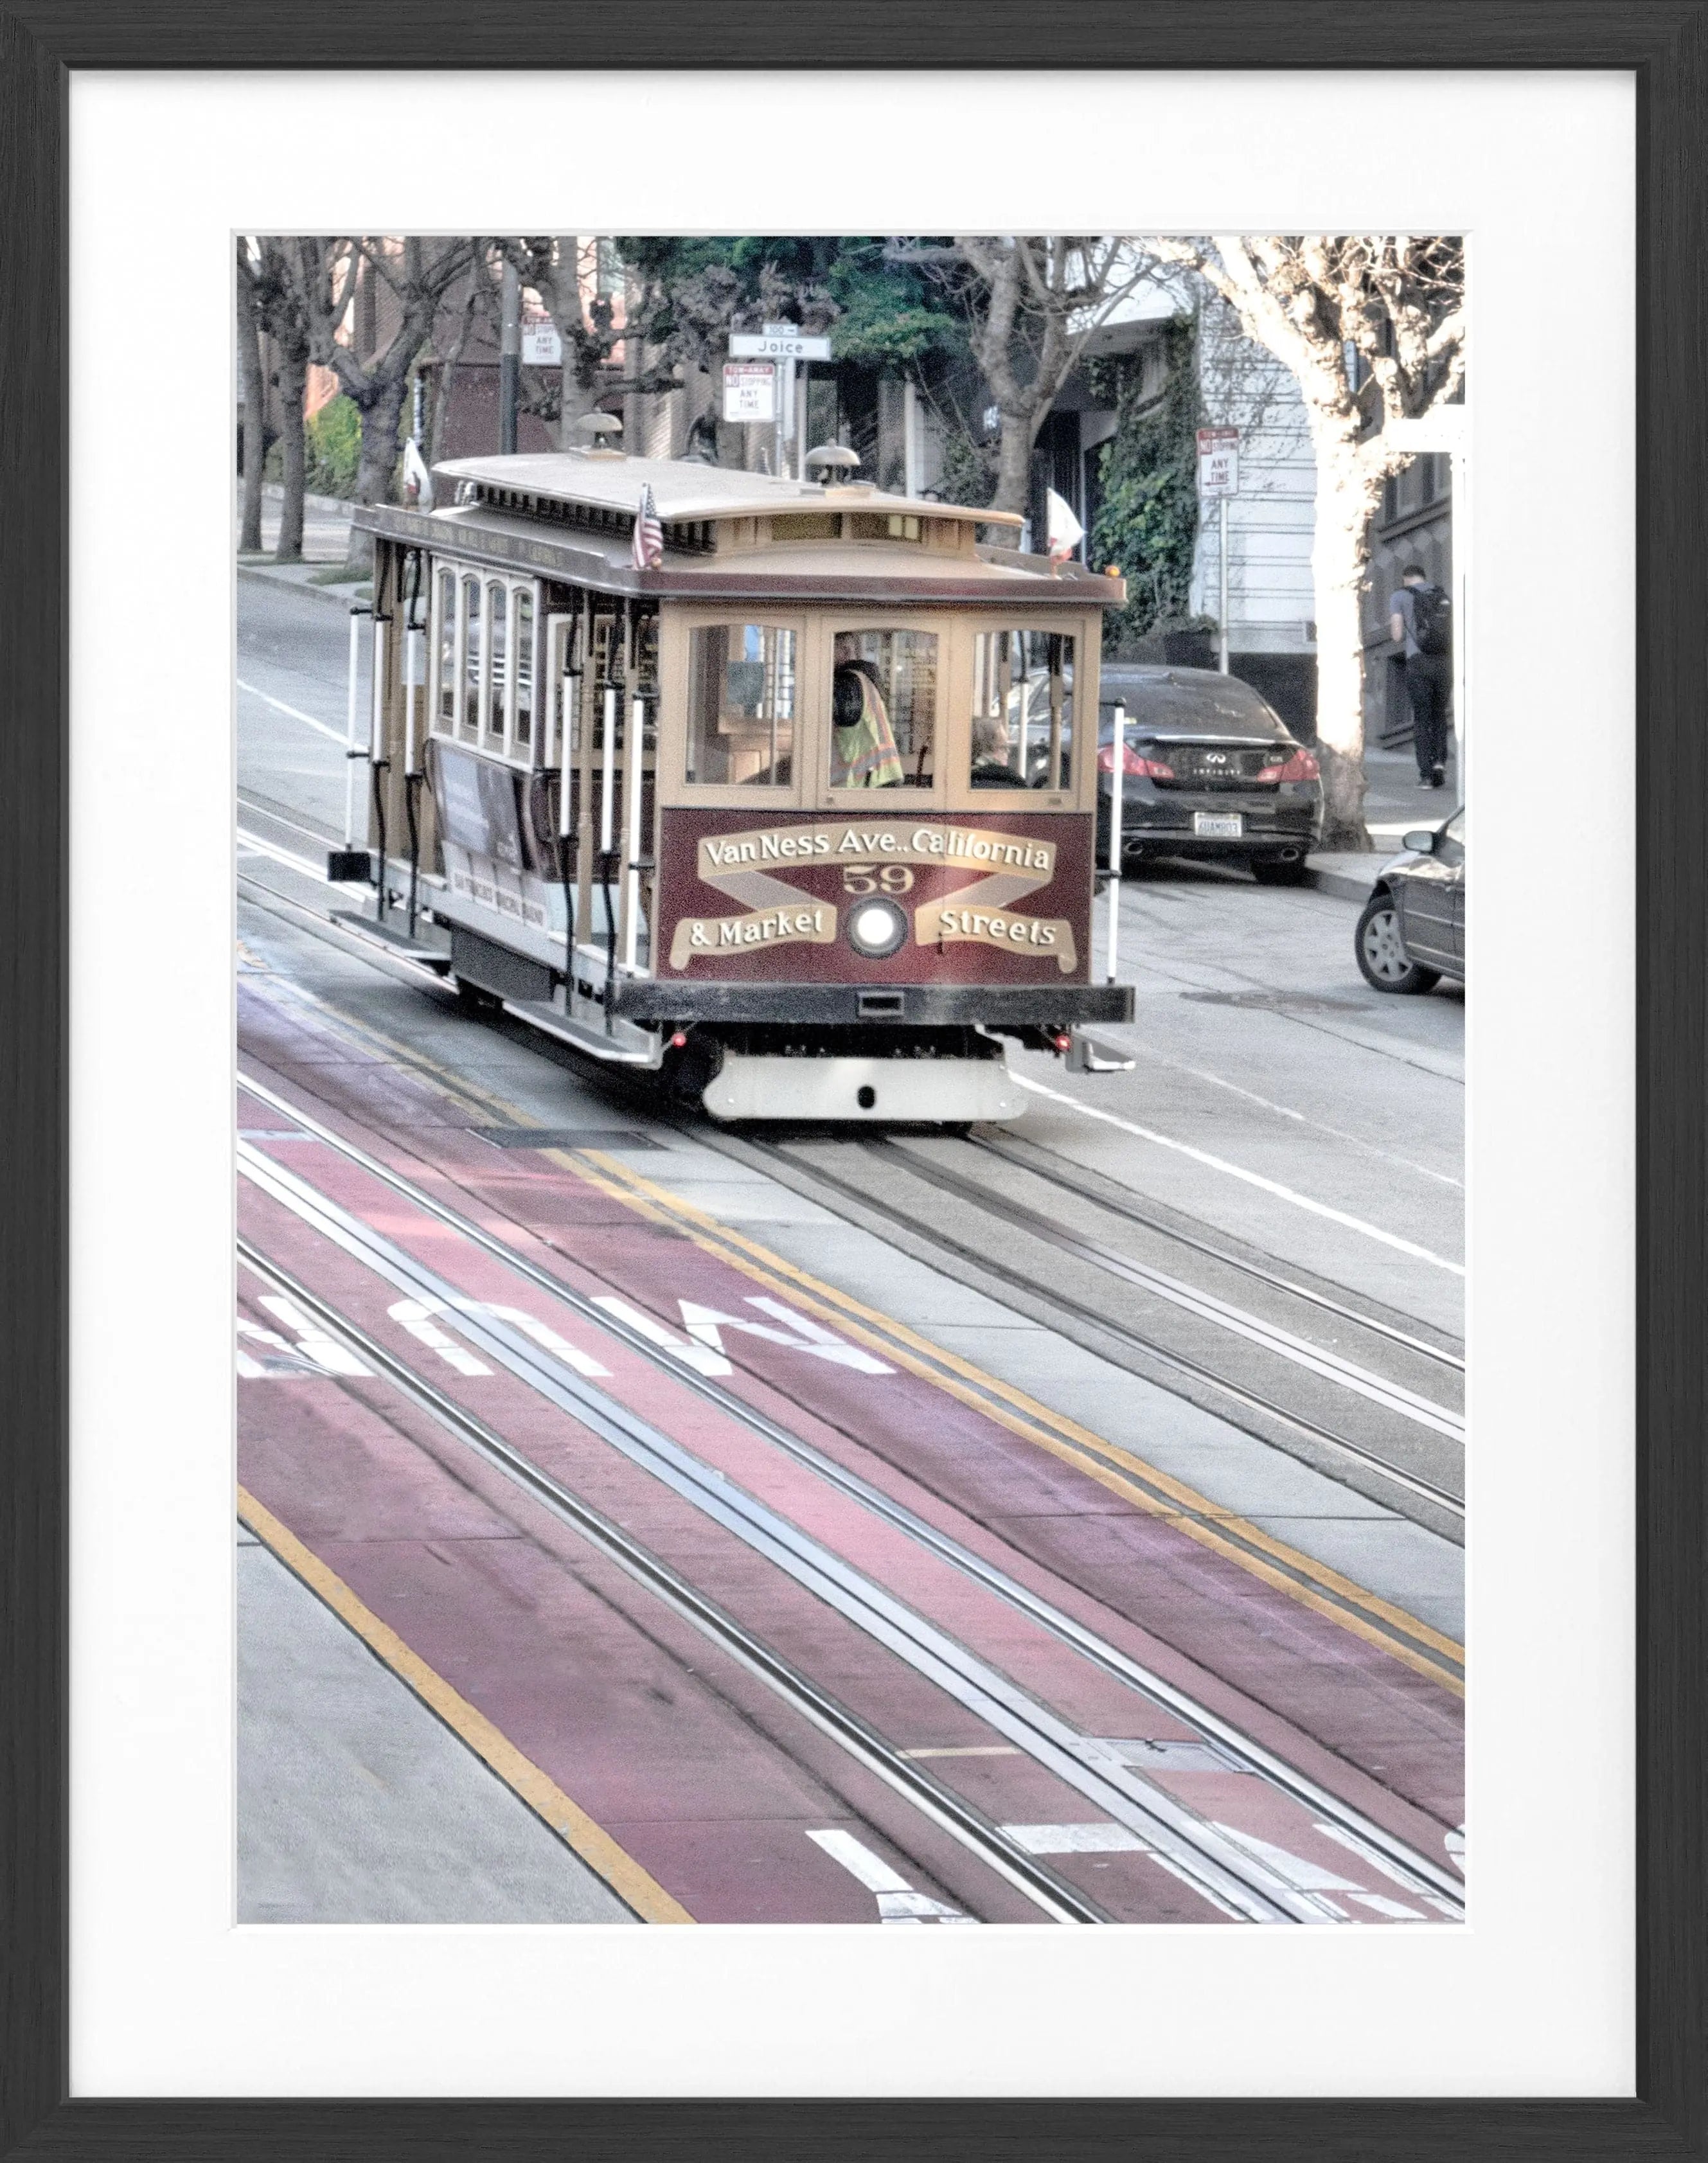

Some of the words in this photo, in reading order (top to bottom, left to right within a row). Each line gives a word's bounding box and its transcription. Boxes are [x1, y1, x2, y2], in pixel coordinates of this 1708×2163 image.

[536, 346, 555, 355] TIME
[758, 341, 803, 353] Joice
[725, 375, 738, 386] NO
[740, 389, 758, 398] ANY
[739, 400, 760, 409] TIME
[1211, 459, 1229, 469] ANY
[1211, 471, 1230, 483] TIME
[706, 840, 756, 866] Van
[760, 834, 832, 860] Ness
[912, 828, 1049, 870] California
[843, 864, 914, 894] 59
[690, 923, 712, 946] &
[719, 910, 823, 946] Market
[940, 910, 1057, 945] Streets
